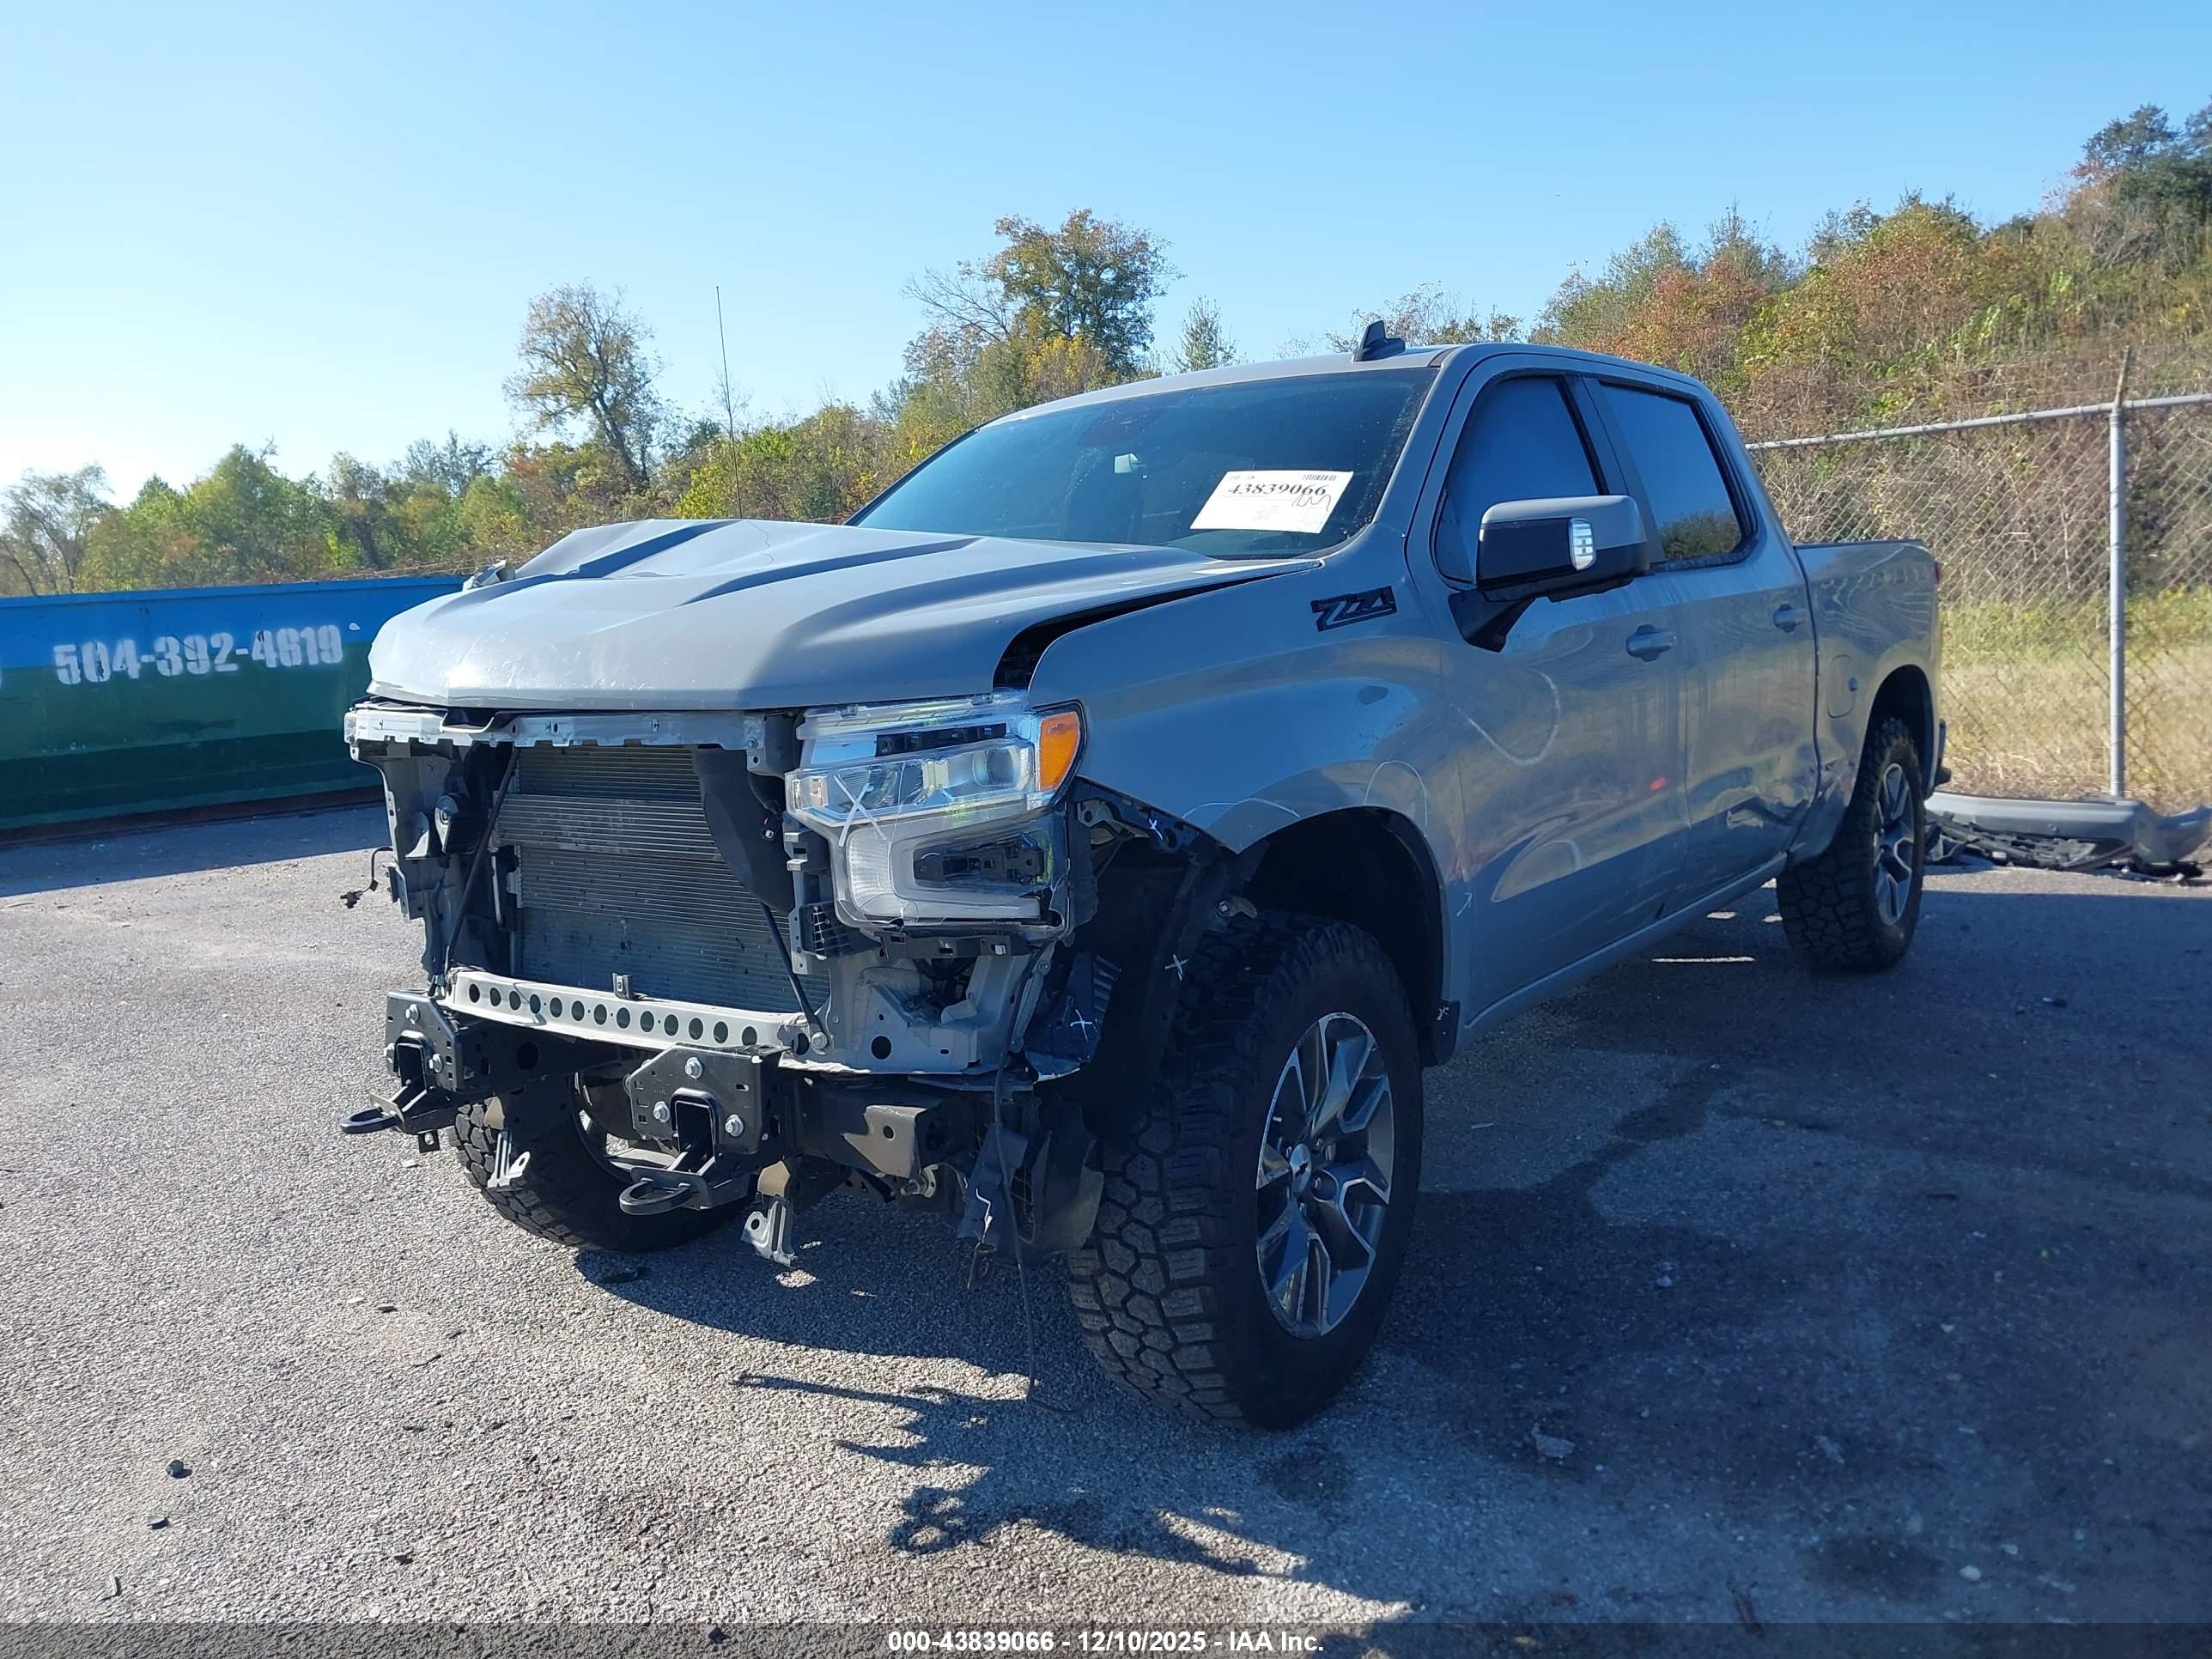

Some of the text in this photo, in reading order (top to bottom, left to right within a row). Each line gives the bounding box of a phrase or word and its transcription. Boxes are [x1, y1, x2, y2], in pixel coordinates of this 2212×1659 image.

[1228, 483, 1331, 496] 43839066
[1310, 585, 1398, 632] Z71
[54, 624, 343, 684] 504-392-4619
